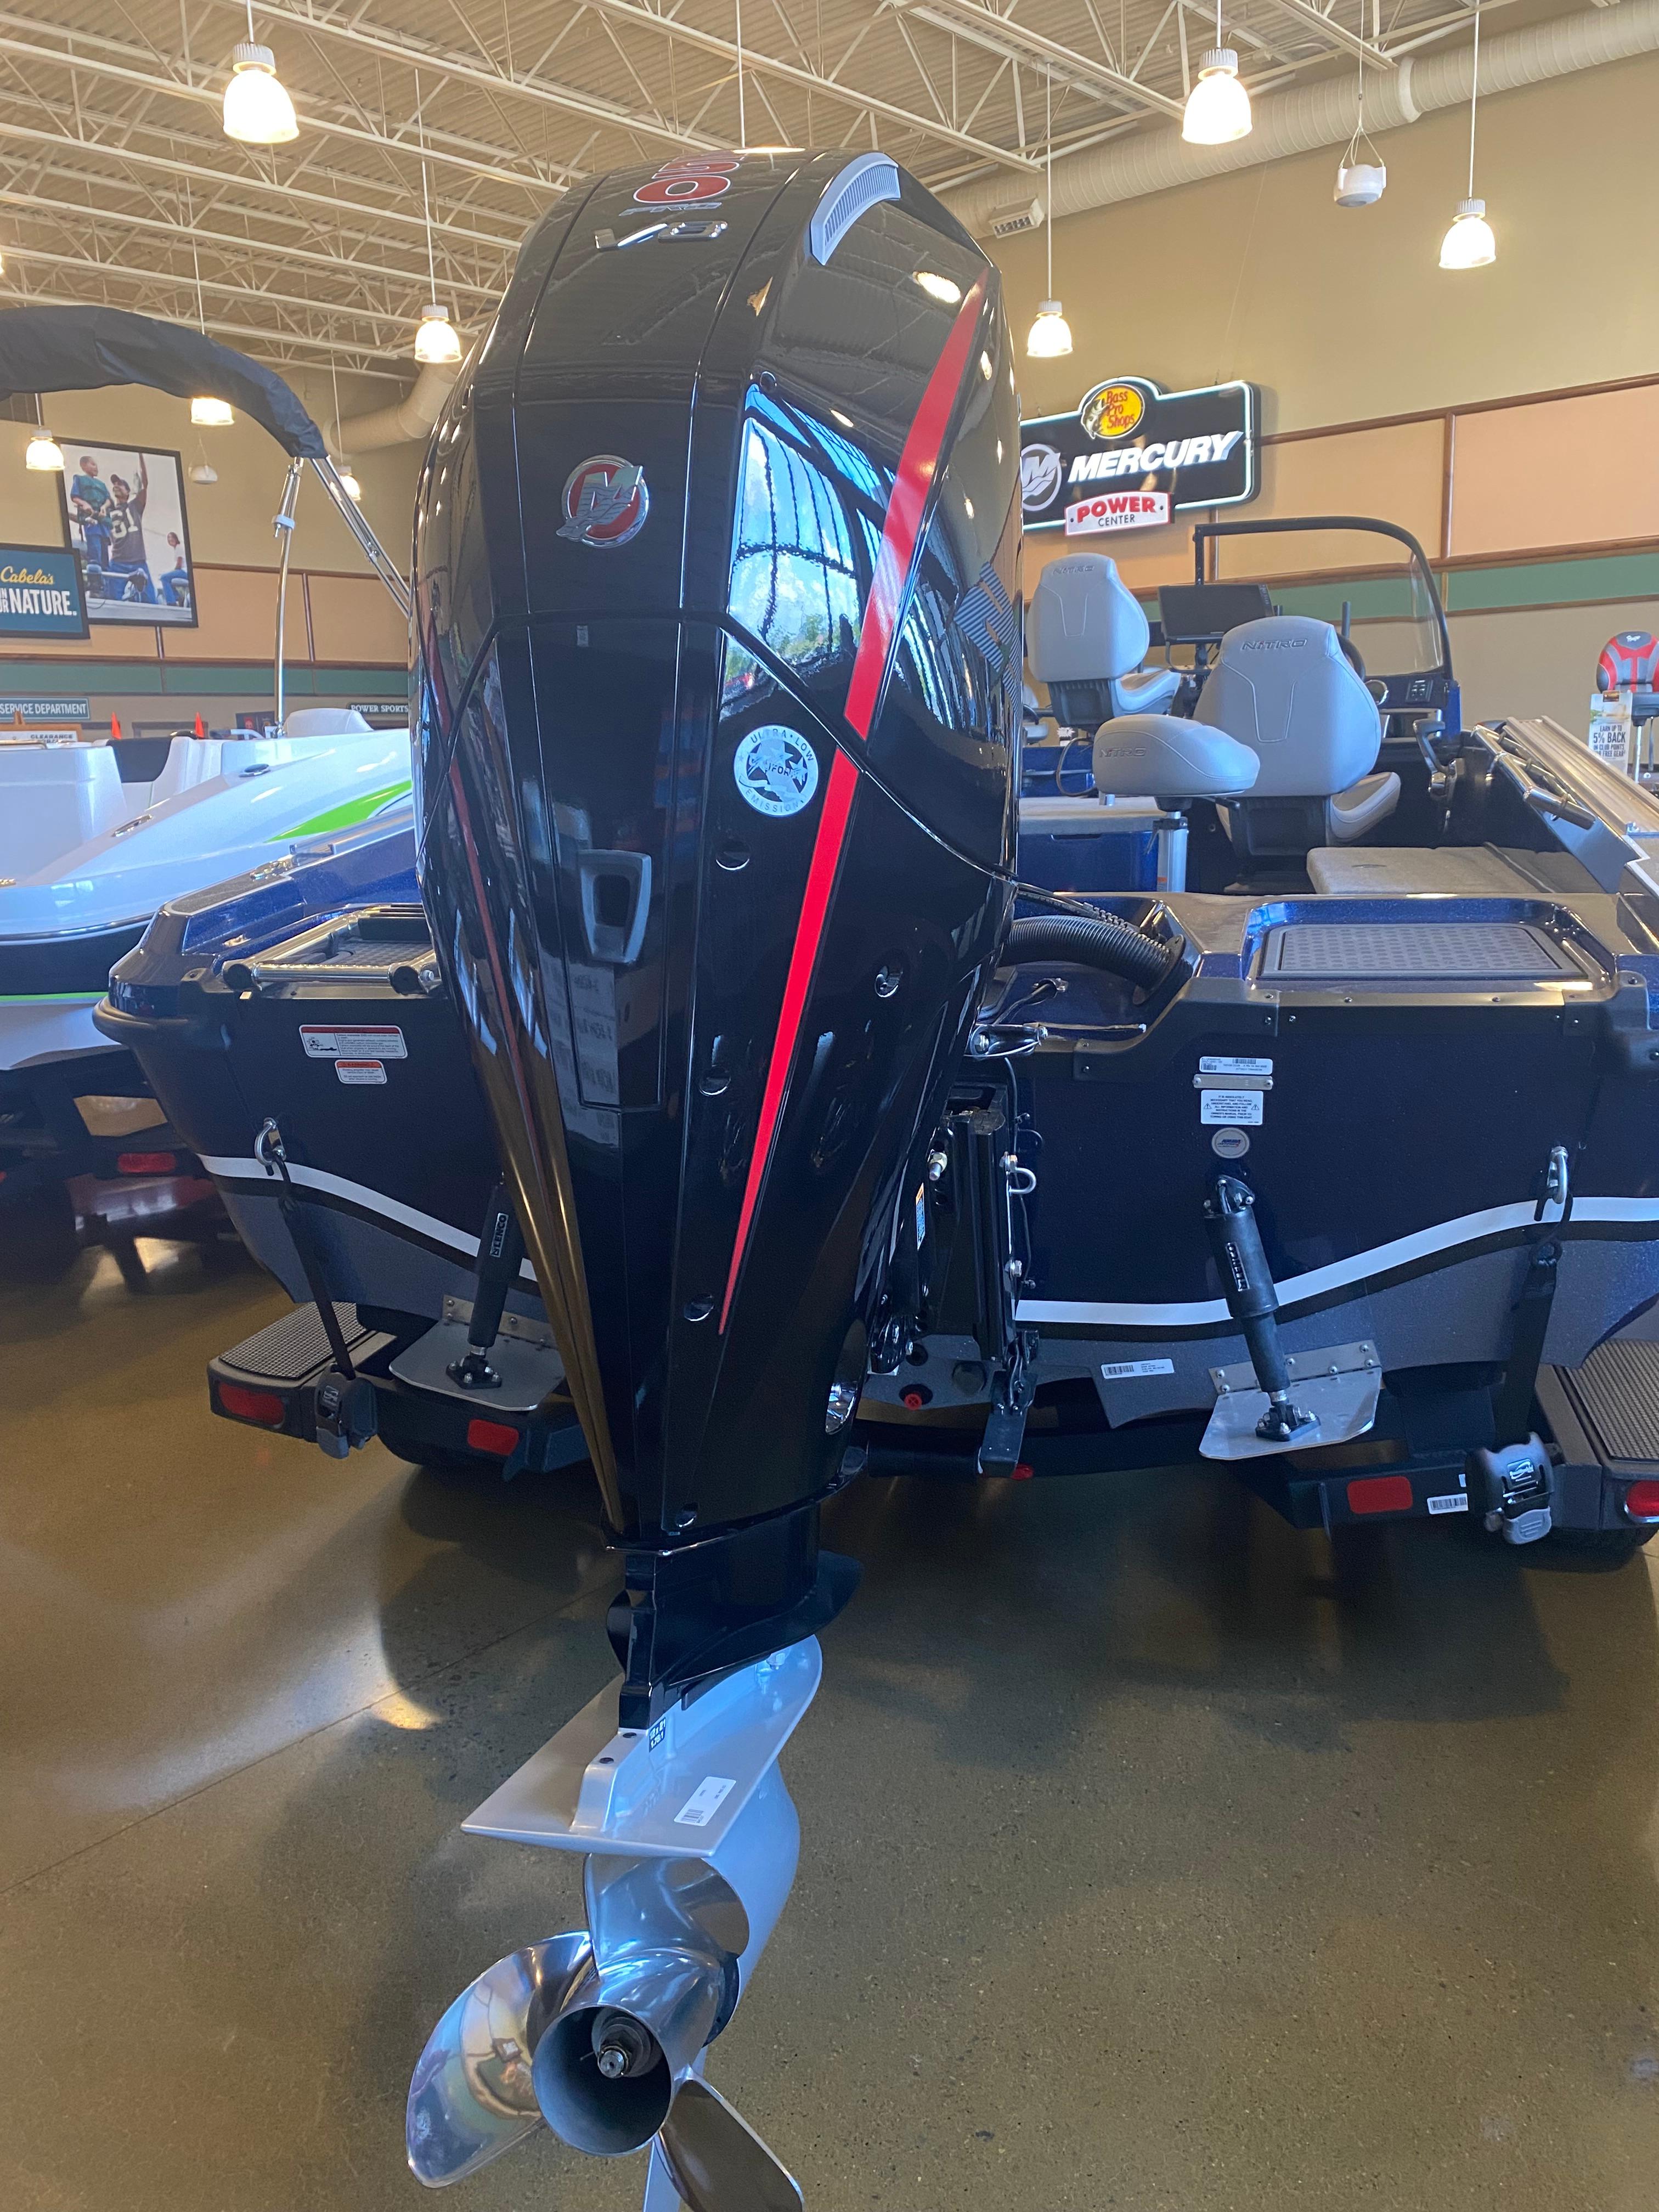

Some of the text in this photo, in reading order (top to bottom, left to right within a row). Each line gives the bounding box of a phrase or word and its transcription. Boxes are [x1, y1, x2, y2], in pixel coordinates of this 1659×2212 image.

[1106, 391, 1128, 404] Bass
[1106, 403, 1124, 416] Pro
[1107, 414, 1135, 428] Shops
[1067, 431, 1244, 483] MERCURY
[1076, 496, 1156, 524] POWER
[1098, 514, 1136, 527] CENTER
[0, 566, 54, 585] Cabela's
[8, 588, 77, 616] NATURE.
[0, 703, 87, 715] SERVICE DEPARTMENT
[380, 704, 409, 713] SPORTS
[1593, 732, 1626, 744] 5% BACK
[795, 737, 815, 761] LOW
